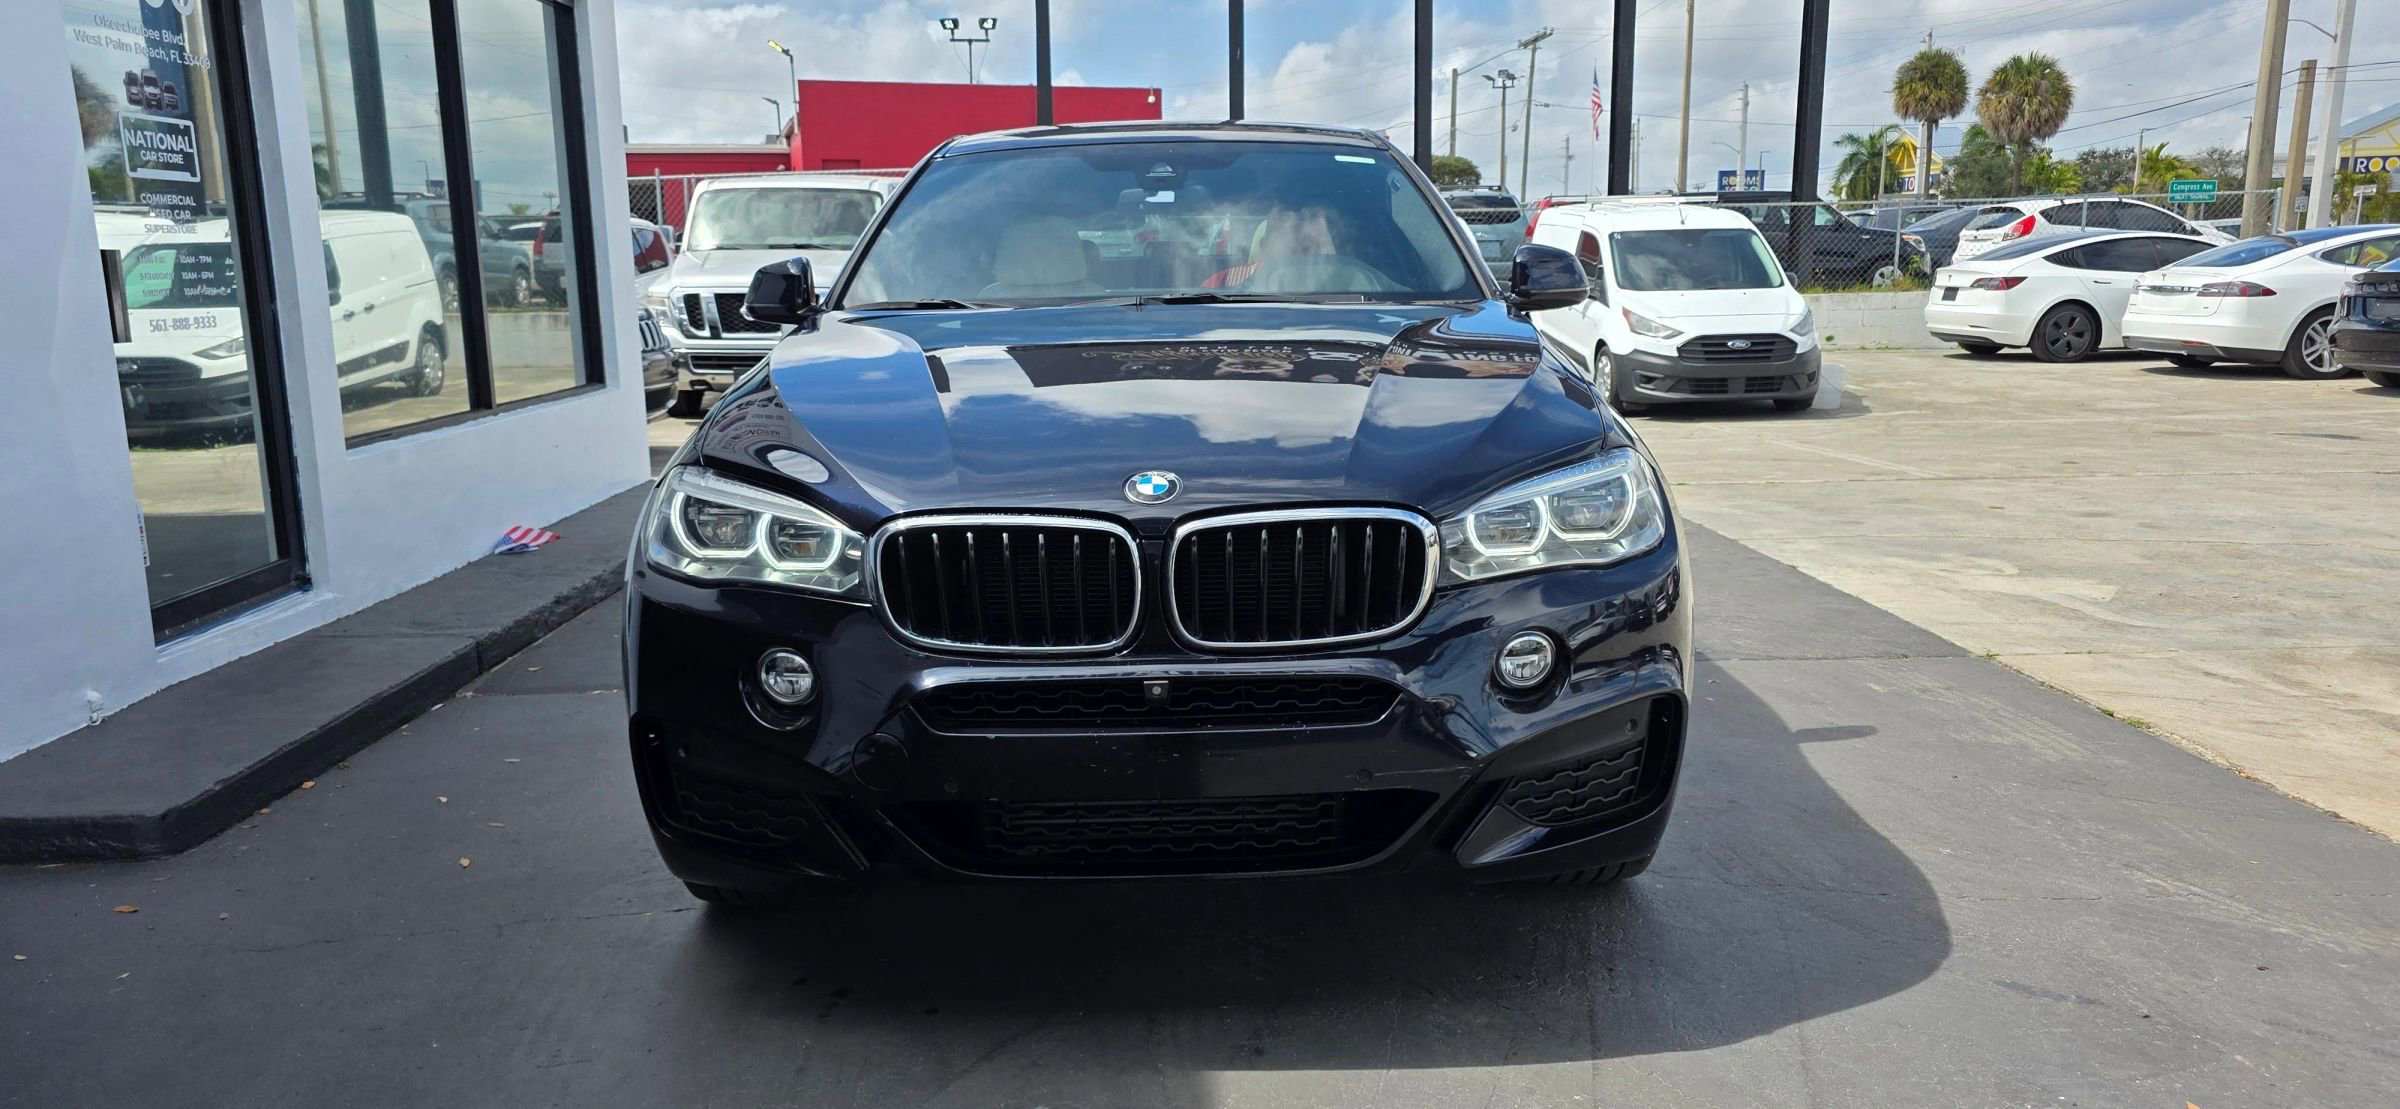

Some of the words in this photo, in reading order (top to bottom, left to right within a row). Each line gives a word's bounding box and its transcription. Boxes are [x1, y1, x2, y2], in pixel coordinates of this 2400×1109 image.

[94, 14, 160, 40] Okeechobee
[162, 30, 186, 46] Blvd.
[73, 28, 103, 48] West
[105, 35, 133, 53] Palm
[134, 43, 169, 63] Beach,
[171, 52, 182, 64] FL
[124, 129, 194, 153] NATIONAL
[140, 150, 158, 162] CAR
[158, 151, 185, 164] STORE
[2173, 183, 2200, 192] Congress
[140, 193, 197, 206] COMMERCIAL
[173, 209, 192, 220] CAR
[144, 223, 199, 235] SUPERSTORE
[150, 315, 217, 332] 561-888-9333
